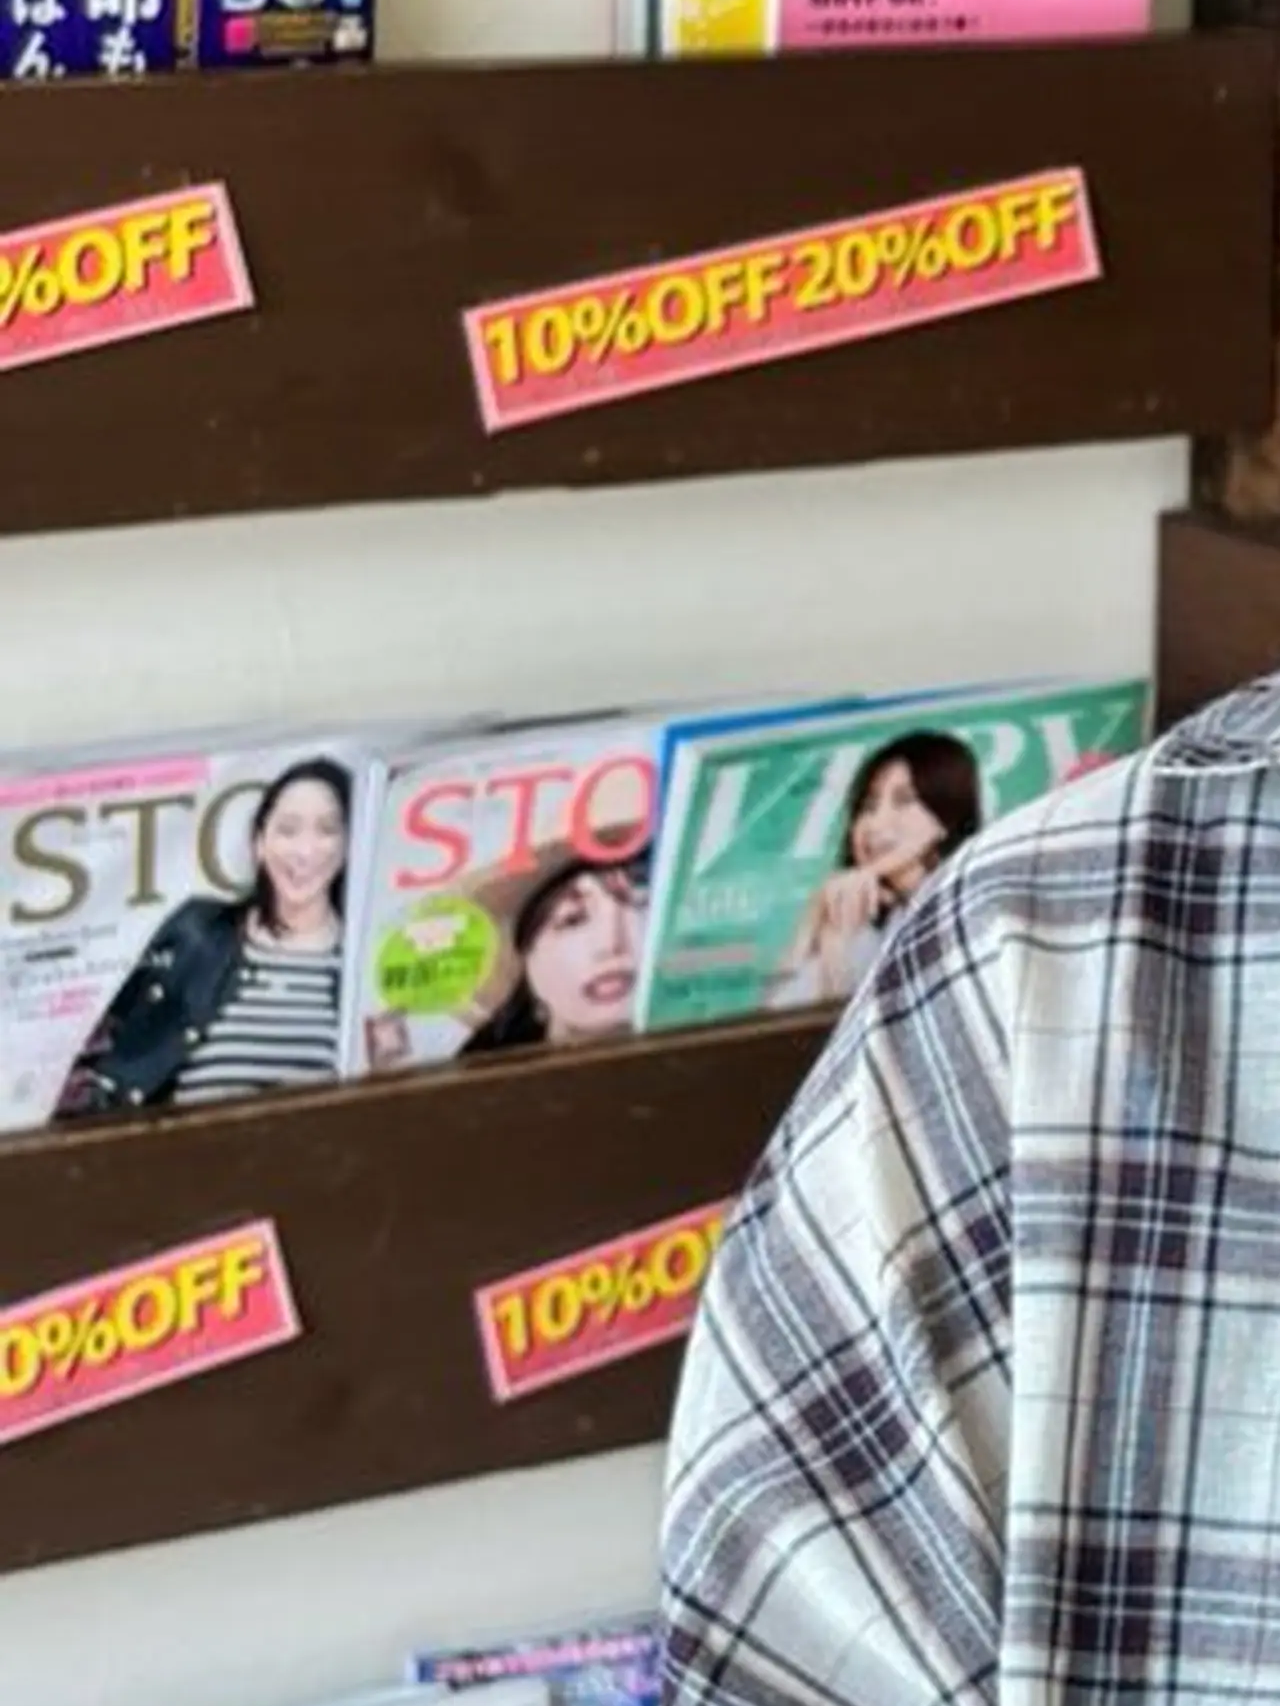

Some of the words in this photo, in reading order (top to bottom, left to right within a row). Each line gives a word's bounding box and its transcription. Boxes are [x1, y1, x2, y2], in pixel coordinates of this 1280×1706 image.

[485, 253, 790, 386] 10%OFF
[791, 183, 1080, 312] 20%OFF
[393, 752, 658, 890] STO
